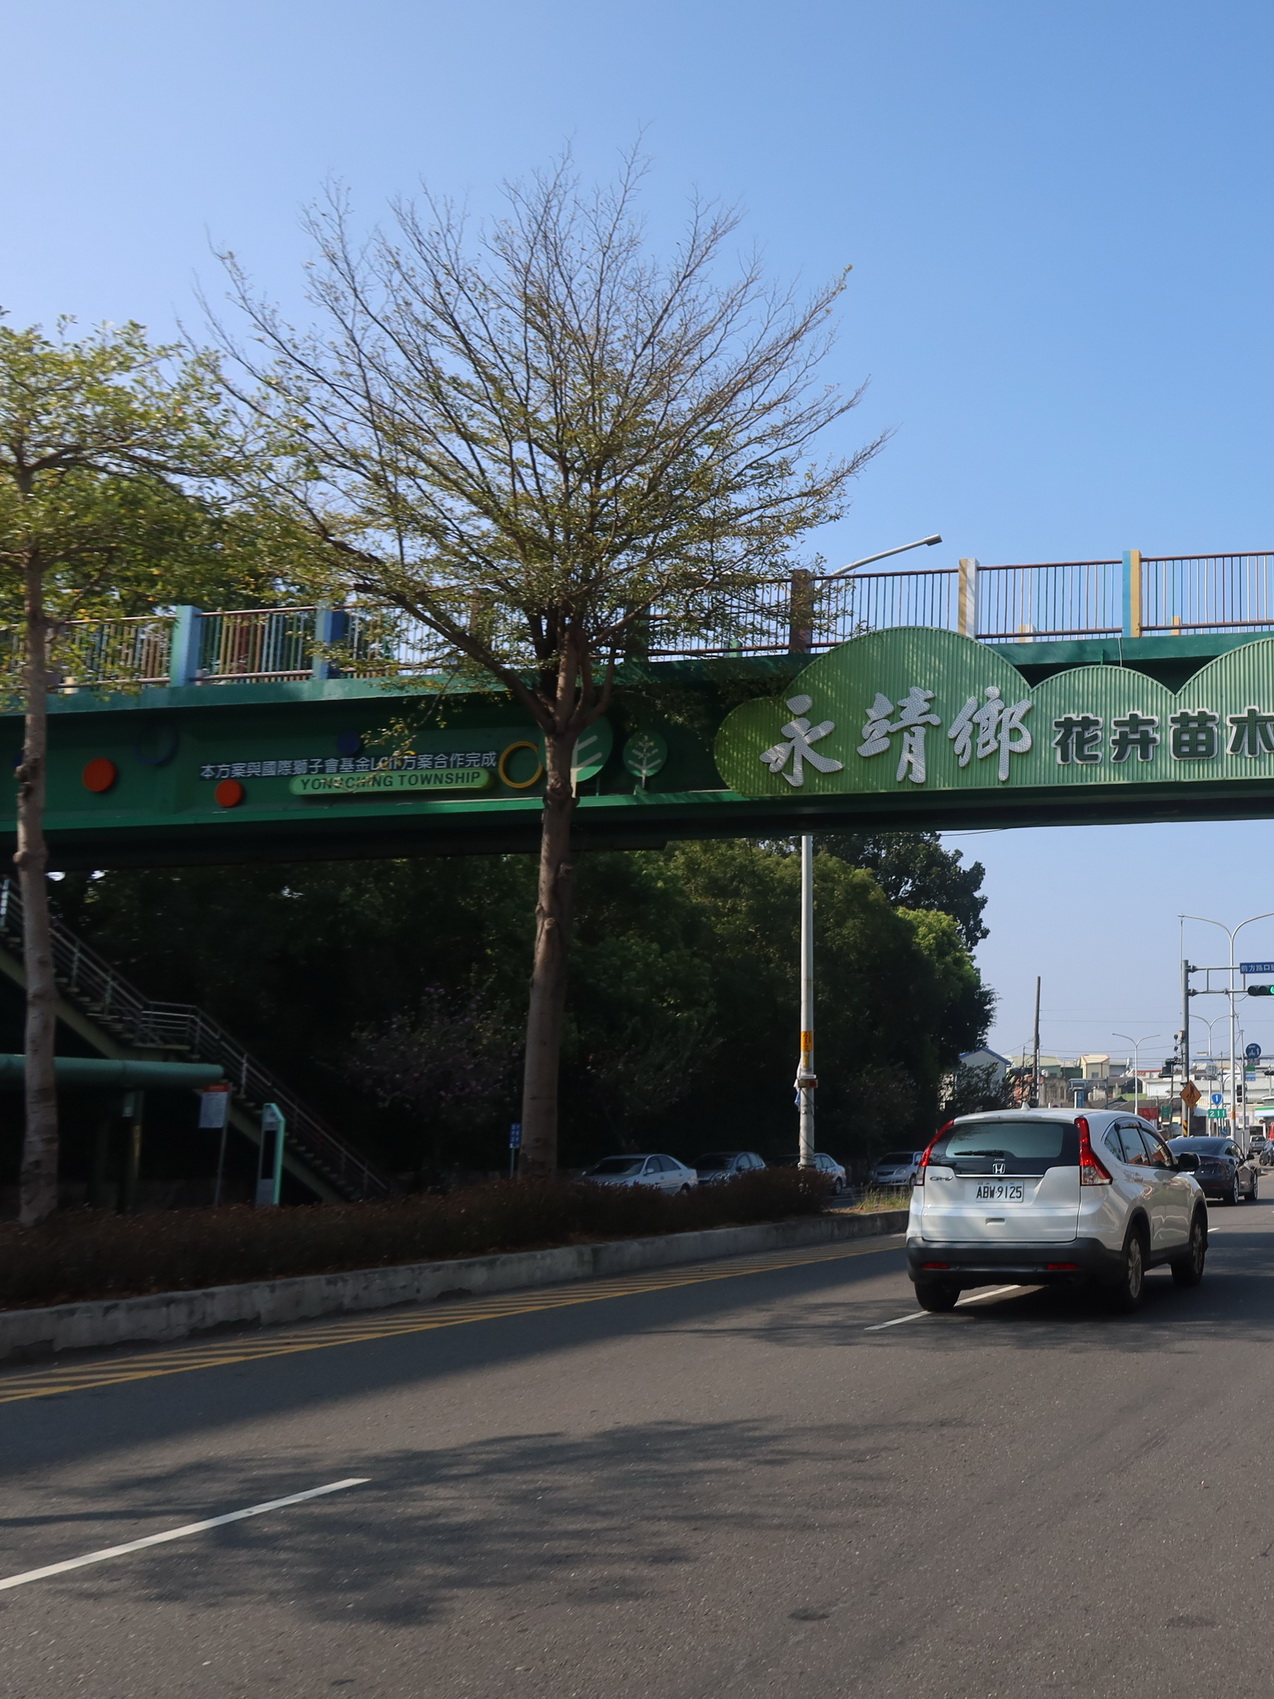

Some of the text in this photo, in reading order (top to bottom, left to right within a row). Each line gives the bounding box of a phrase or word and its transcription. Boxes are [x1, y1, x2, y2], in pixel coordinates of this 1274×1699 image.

[759, 686, 1034, 788] 永靖鄉
[398, 771, 481, 787] TOWNSHIP
[1209, 1110, 1226, 1118] 211
